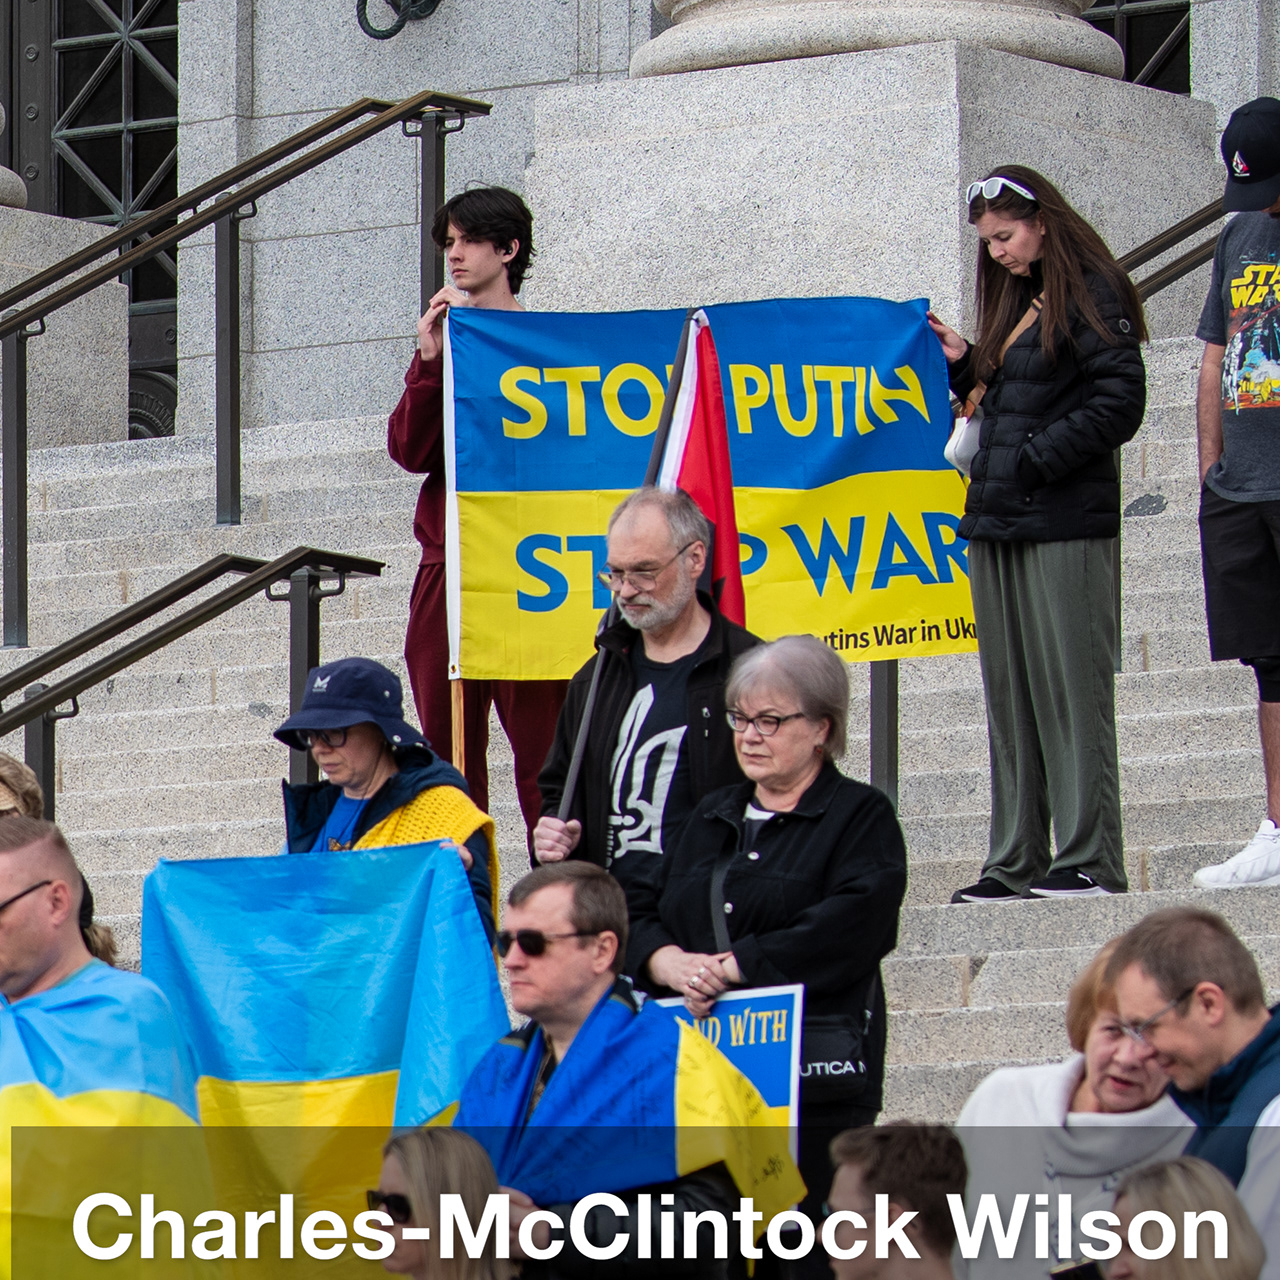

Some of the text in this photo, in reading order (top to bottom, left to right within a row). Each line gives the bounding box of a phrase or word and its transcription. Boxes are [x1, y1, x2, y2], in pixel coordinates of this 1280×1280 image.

[499, 363, 931, 440] STO PUTIN
[515, 511, 969, 613] STP WAR
[801, 628, 869, 651] utins
[873, 624, 917, 647] War
[920, 619, 941, 642] in
[729, 1007, 787, 1047] WITH
[800, 1061, 856, 1077] UTICA
